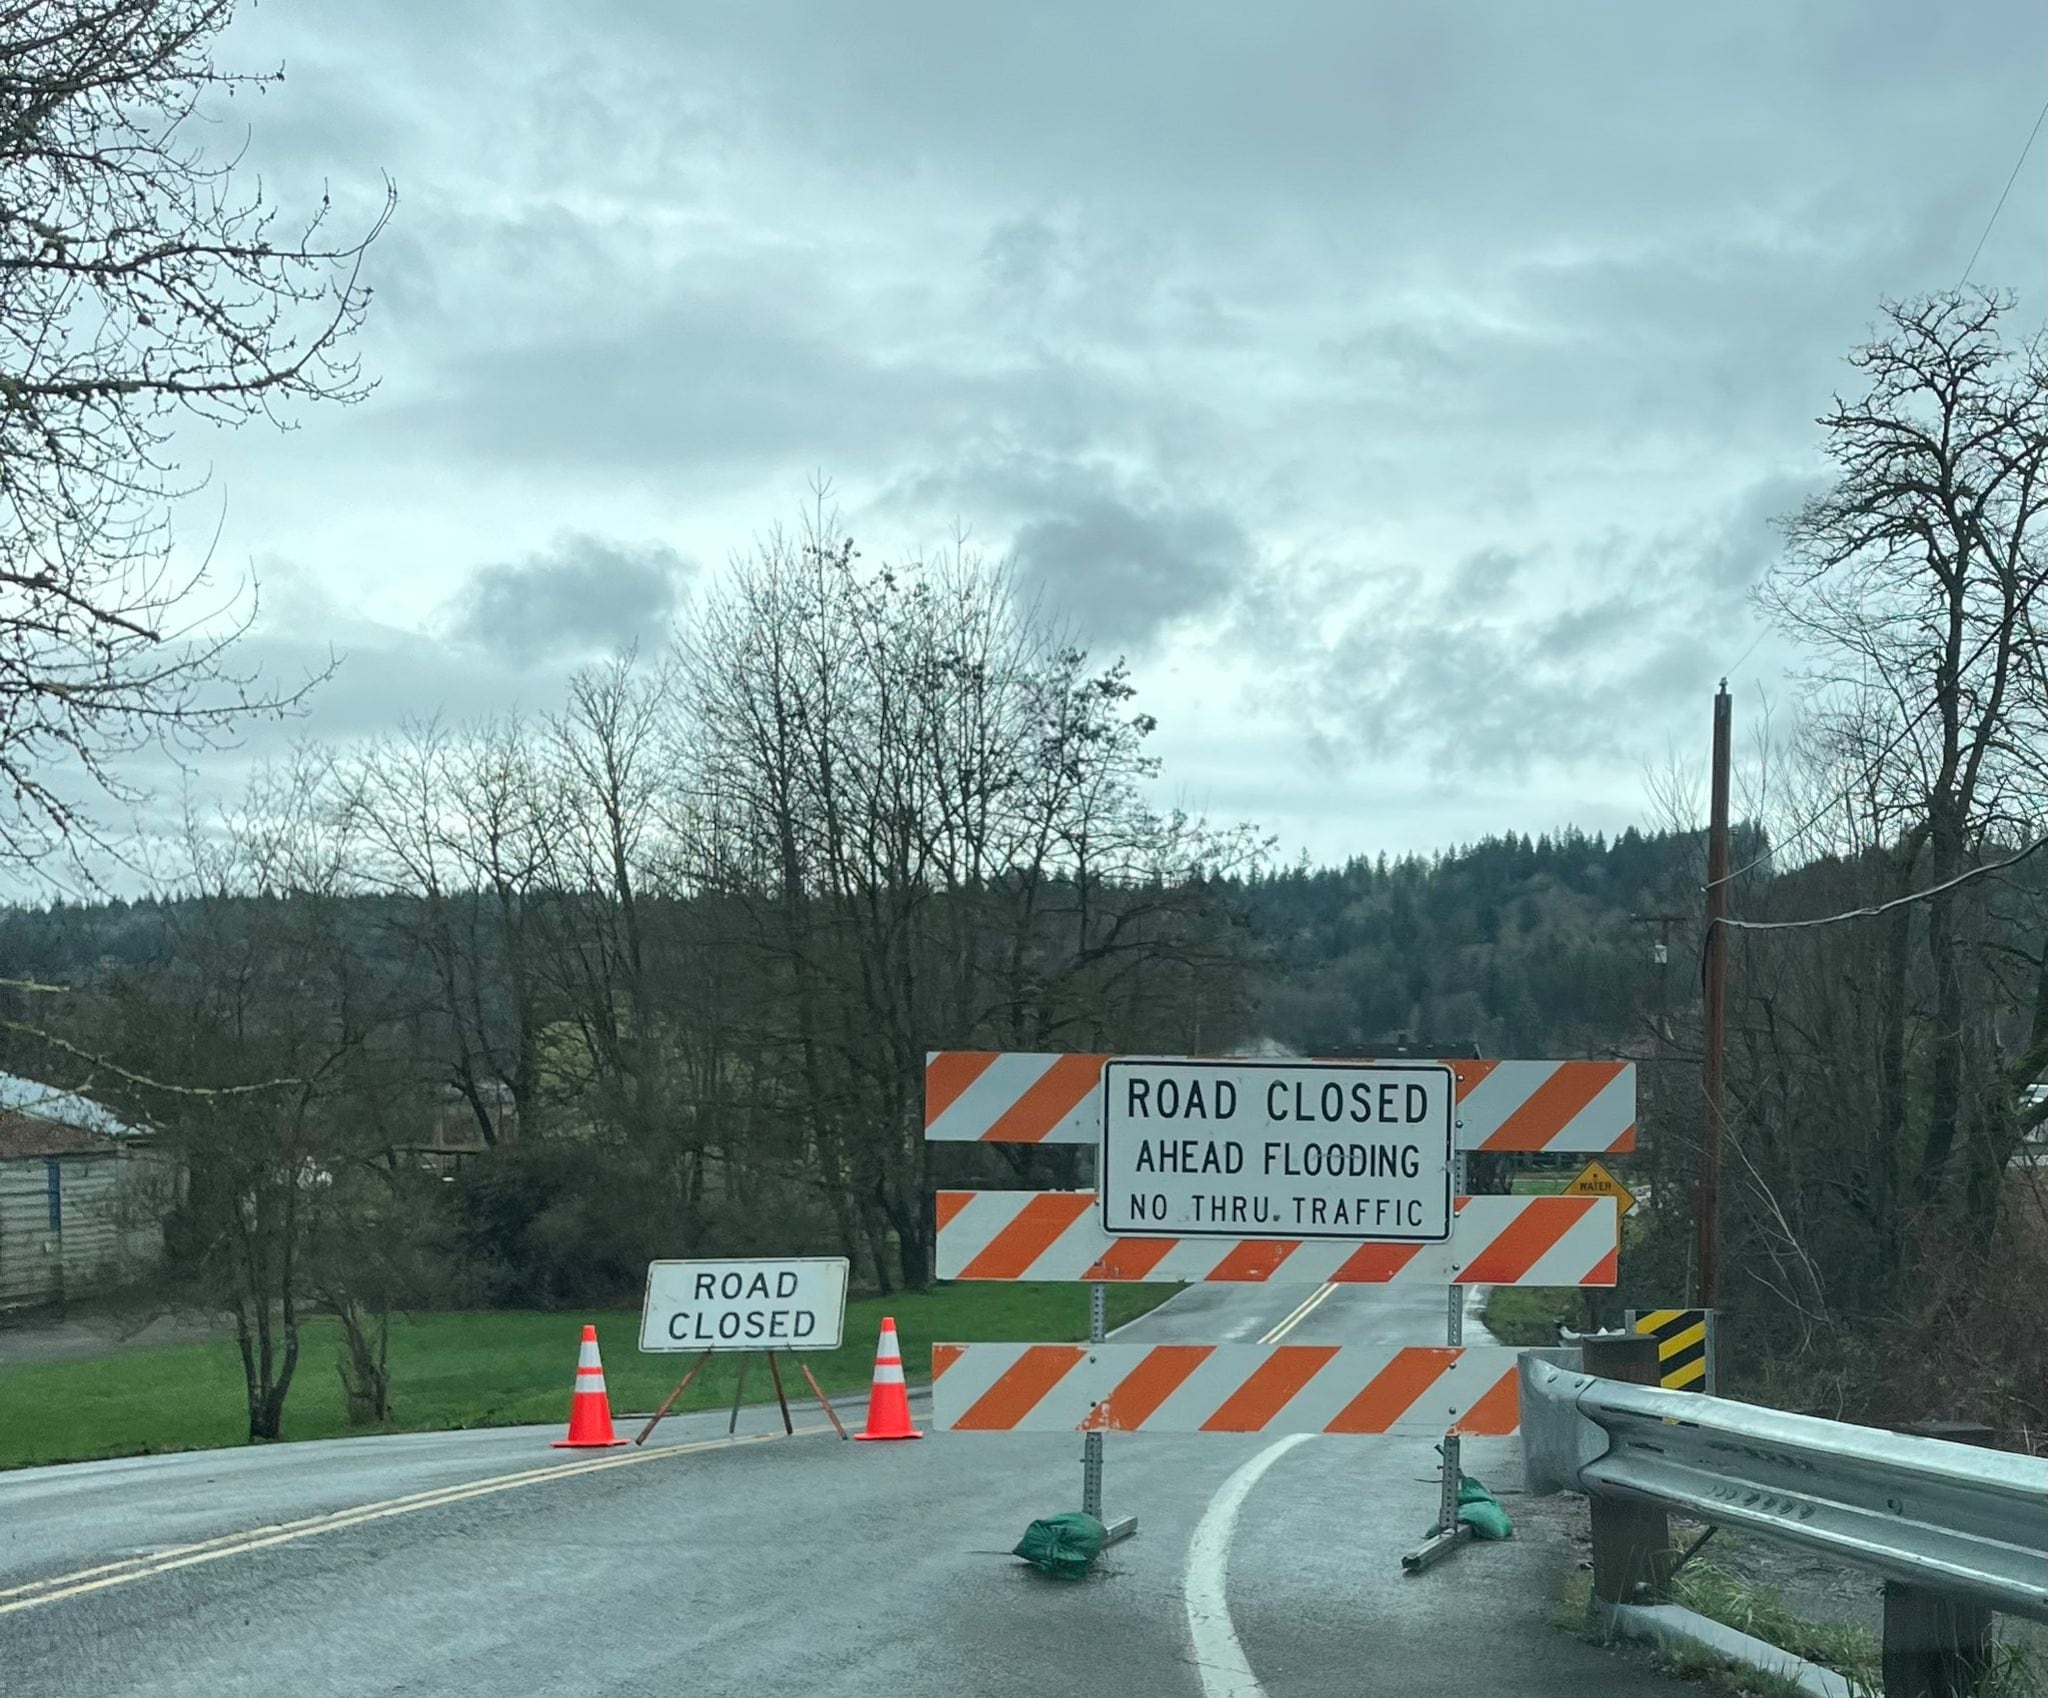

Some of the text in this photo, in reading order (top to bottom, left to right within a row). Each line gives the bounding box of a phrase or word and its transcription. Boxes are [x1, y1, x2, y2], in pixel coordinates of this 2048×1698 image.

[1128, 1078, 1428, 1123] ROAD CLOSED
[1136, 1140, 1420, 1179] AHEAD FLOODING
[1580, 1182, 1611, 1191] WATER
[1130, 1193, 1423, 1227] NO THRU TRAFFIC
[694, 1271, 798, 1300] ROAD
[668, 1310, 815, 1340] CLOSED
